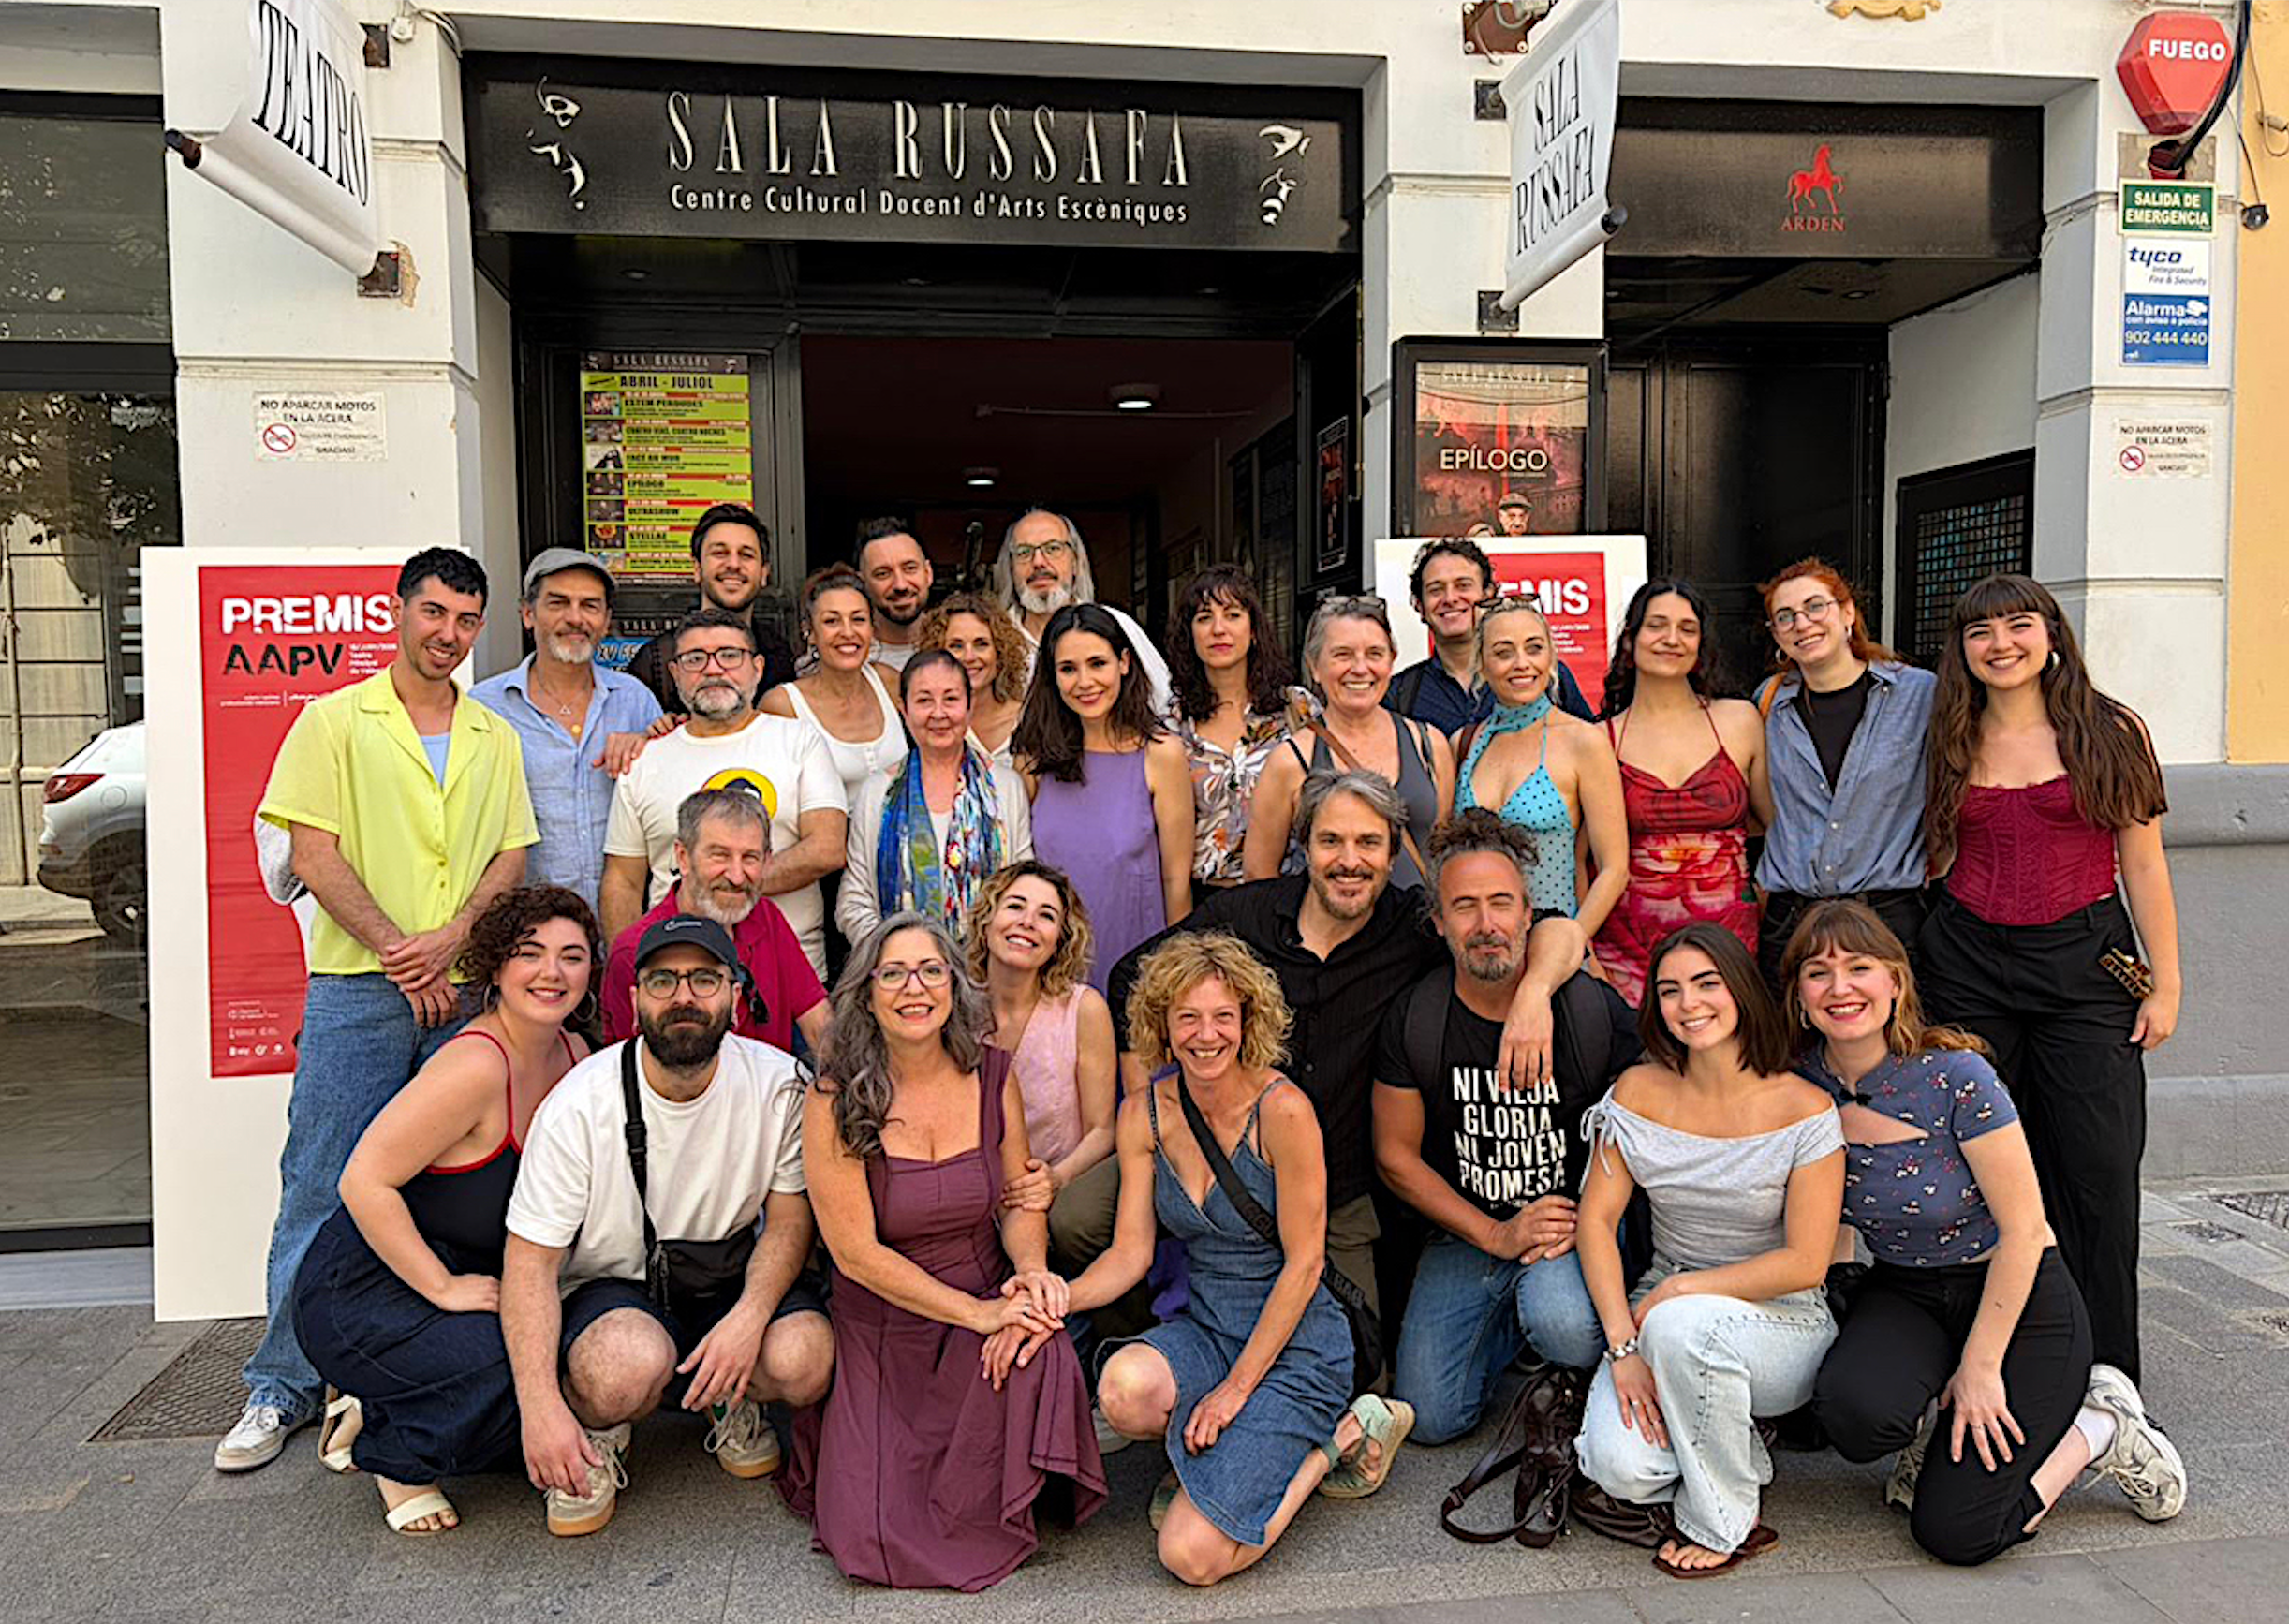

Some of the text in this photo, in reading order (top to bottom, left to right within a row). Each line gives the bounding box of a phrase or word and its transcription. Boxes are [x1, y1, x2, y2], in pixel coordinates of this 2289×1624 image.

[2149, 39, 2227, 61] FUEGO
[251, 0, 369, 207] TEATRO
[1534, 42, 1581, 155] SALA
[667, 91, 1190, 187] SALA RUSSAFA
[1515, 121, 1595, 257] RUSSAFA
[2134, 191, 2201, 208] SALIDA DE
[670, 185, 1188, 227] Centre Cultural Docent d'Arts Escèniques
[2125, 208, 2209, 226] EMERGENCIA
[1780, 216, 1846, 232] ARDEN
[2129, 246, 2182, 267] tyco
[2149, 275, 2164, 284] Fire
[2174, 276, 2207, 286] Security
[2152, 266, 2195, 274] Integrated
[2126, 300, 2186, 317] Alarma
[2125, 331, 2208, 346] 902 444 440
[620, 376, 658, 388] ABRIL
[672, 376, 714, 389] JULIOL
[261, 400, 376, 411] NO APARCAR MOTOS
[283, 413, 353, 423] EN LA ACERA
[2161, 436, 2188, 445] ACERA
[1440, 442, 1550, 471] EPÍLOGO
[1499, 579, 1590, 615] MIS
[221, 593, 397, 634] PREMIS
[222, 643, 344, 677] AAPV
[1453, 1066, 1481, 1102] NI
[1463, 1102, 1553, 1140] GLORIA
[1454, 1129, 1567, 1168] NI JOVEN
[1458, 1159, 1567, 1202] PROMESA
